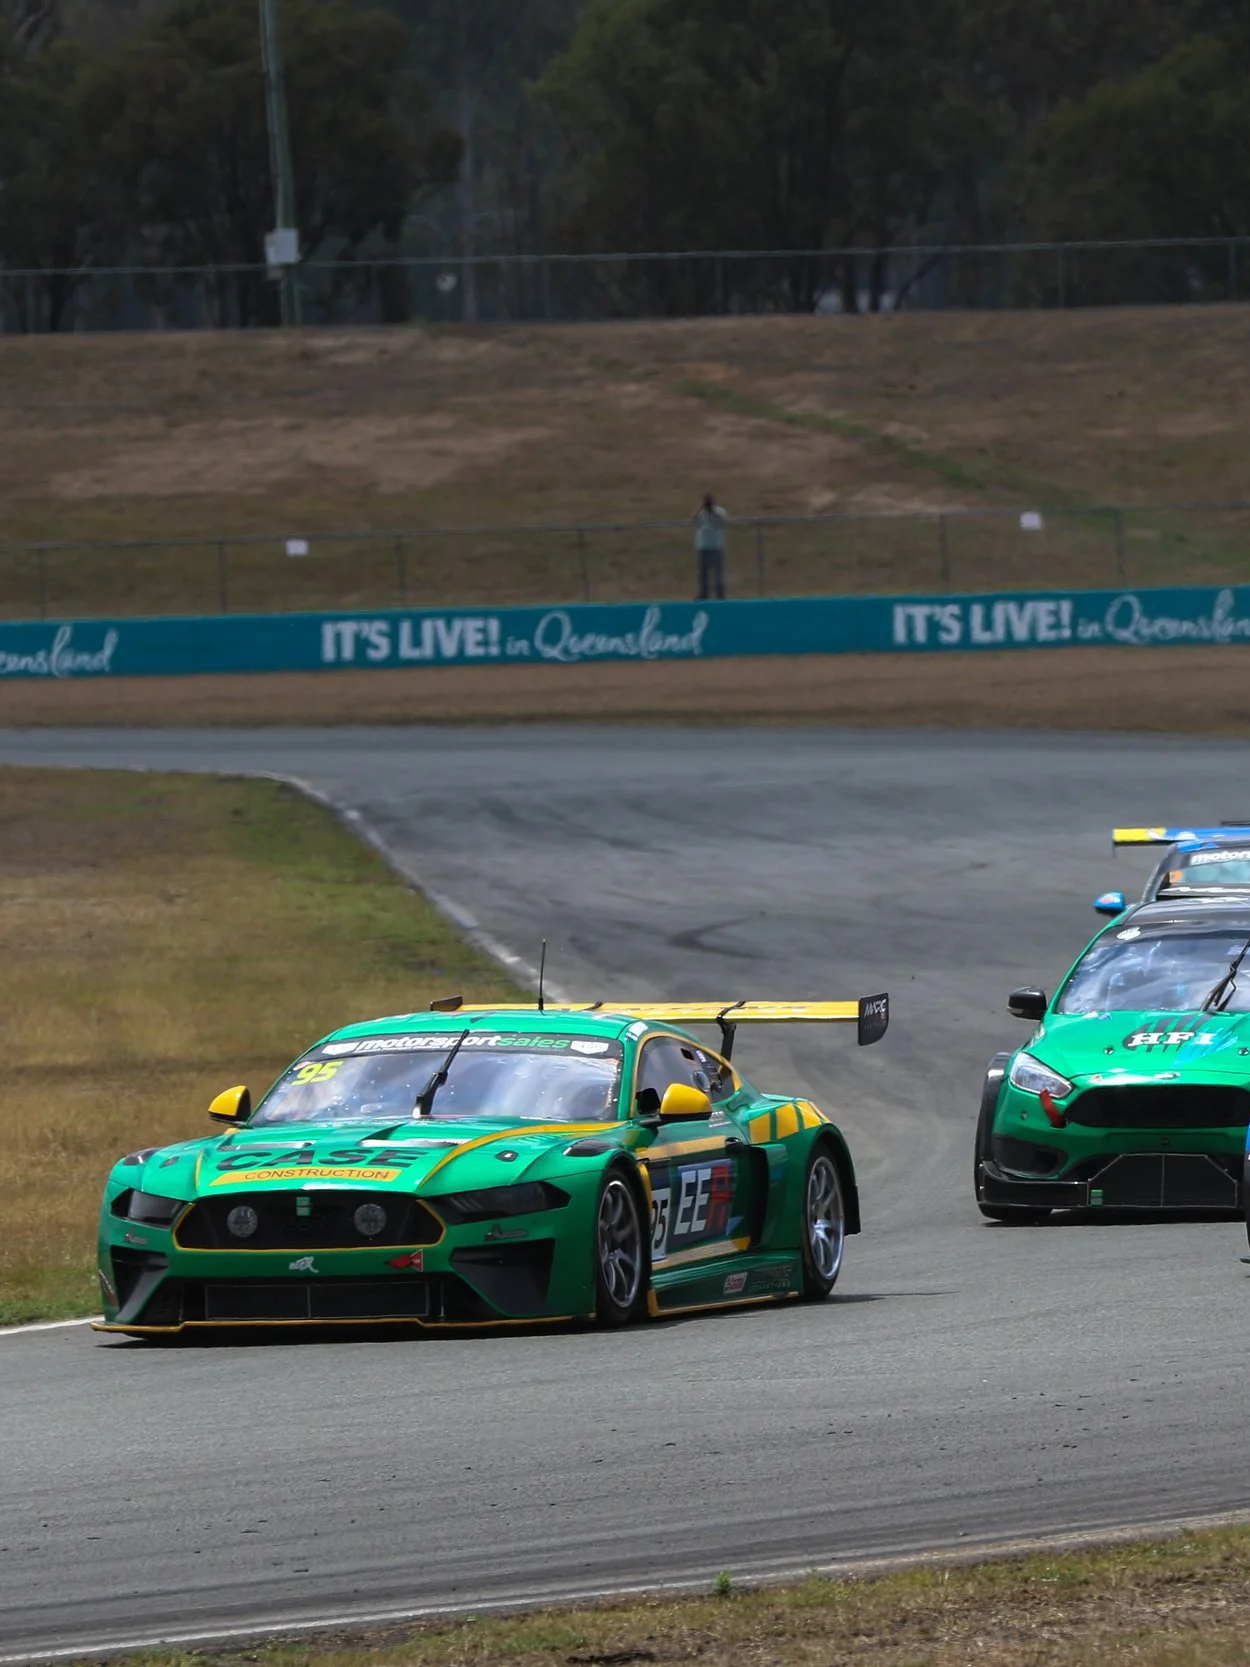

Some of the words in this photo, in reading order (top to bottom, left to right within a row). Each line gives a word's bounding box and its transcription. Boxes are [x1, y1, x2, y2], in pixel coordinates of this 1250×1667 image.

[321, 620, 390, 662] IT'S
[399, 617, 499, 660] LIVE!
[506, 636, 531, 656] in
[534, 604, 709, 661] Queensland
[893, 604, 962, 644] IT'S
[969, 600, 1073, 643] LIVE!
[1077, 618, 1102, 638] in
[356, 1035, 571, 1052] motorsportsales
[291, 1060, 345, 1086] 95
[216, 1149, 429, 1171] CASE
[244, 1168, 390, 1181] CONSTRUCTION
